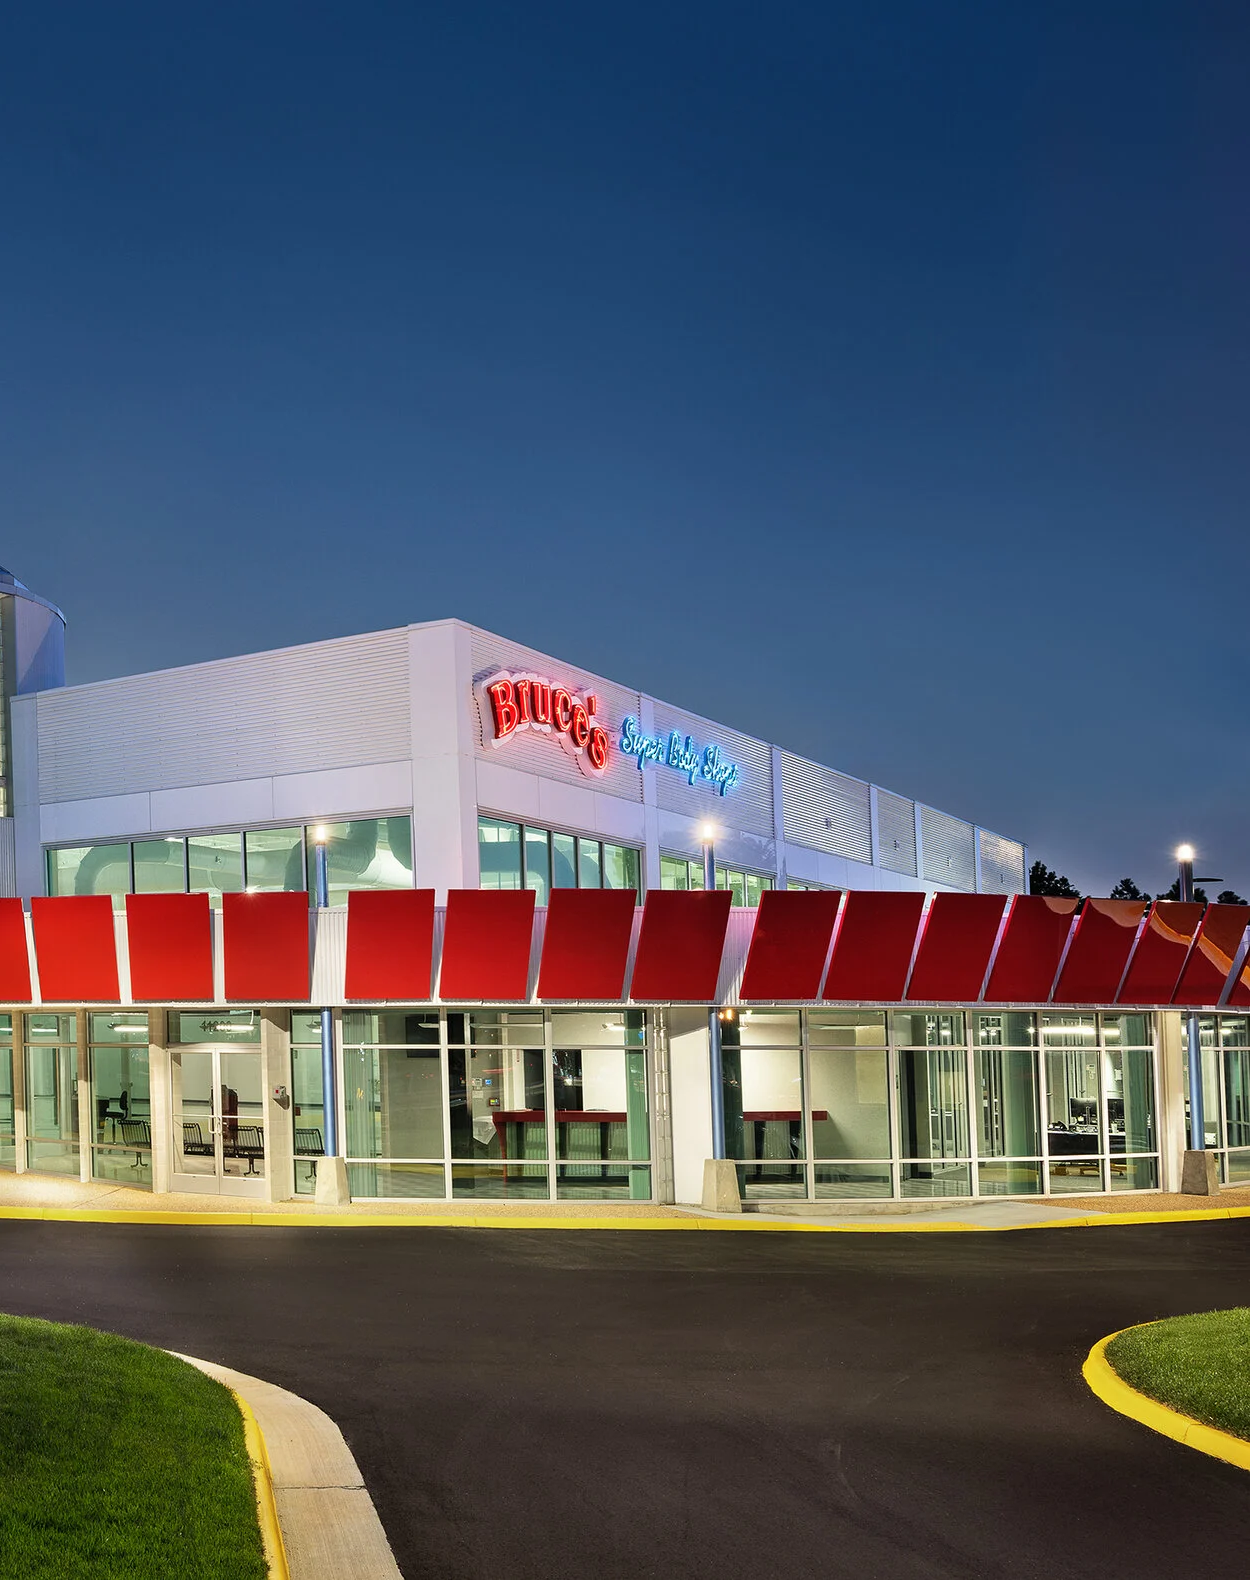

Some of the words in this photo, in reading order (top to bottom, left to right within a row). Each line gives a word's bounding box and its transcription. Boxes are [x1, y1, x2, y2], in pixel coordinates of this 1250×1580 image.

[487, 679, 609, 770] Bruce's
[619, 716, 664, 770] Super
[666, 730, 699, 785] Body
